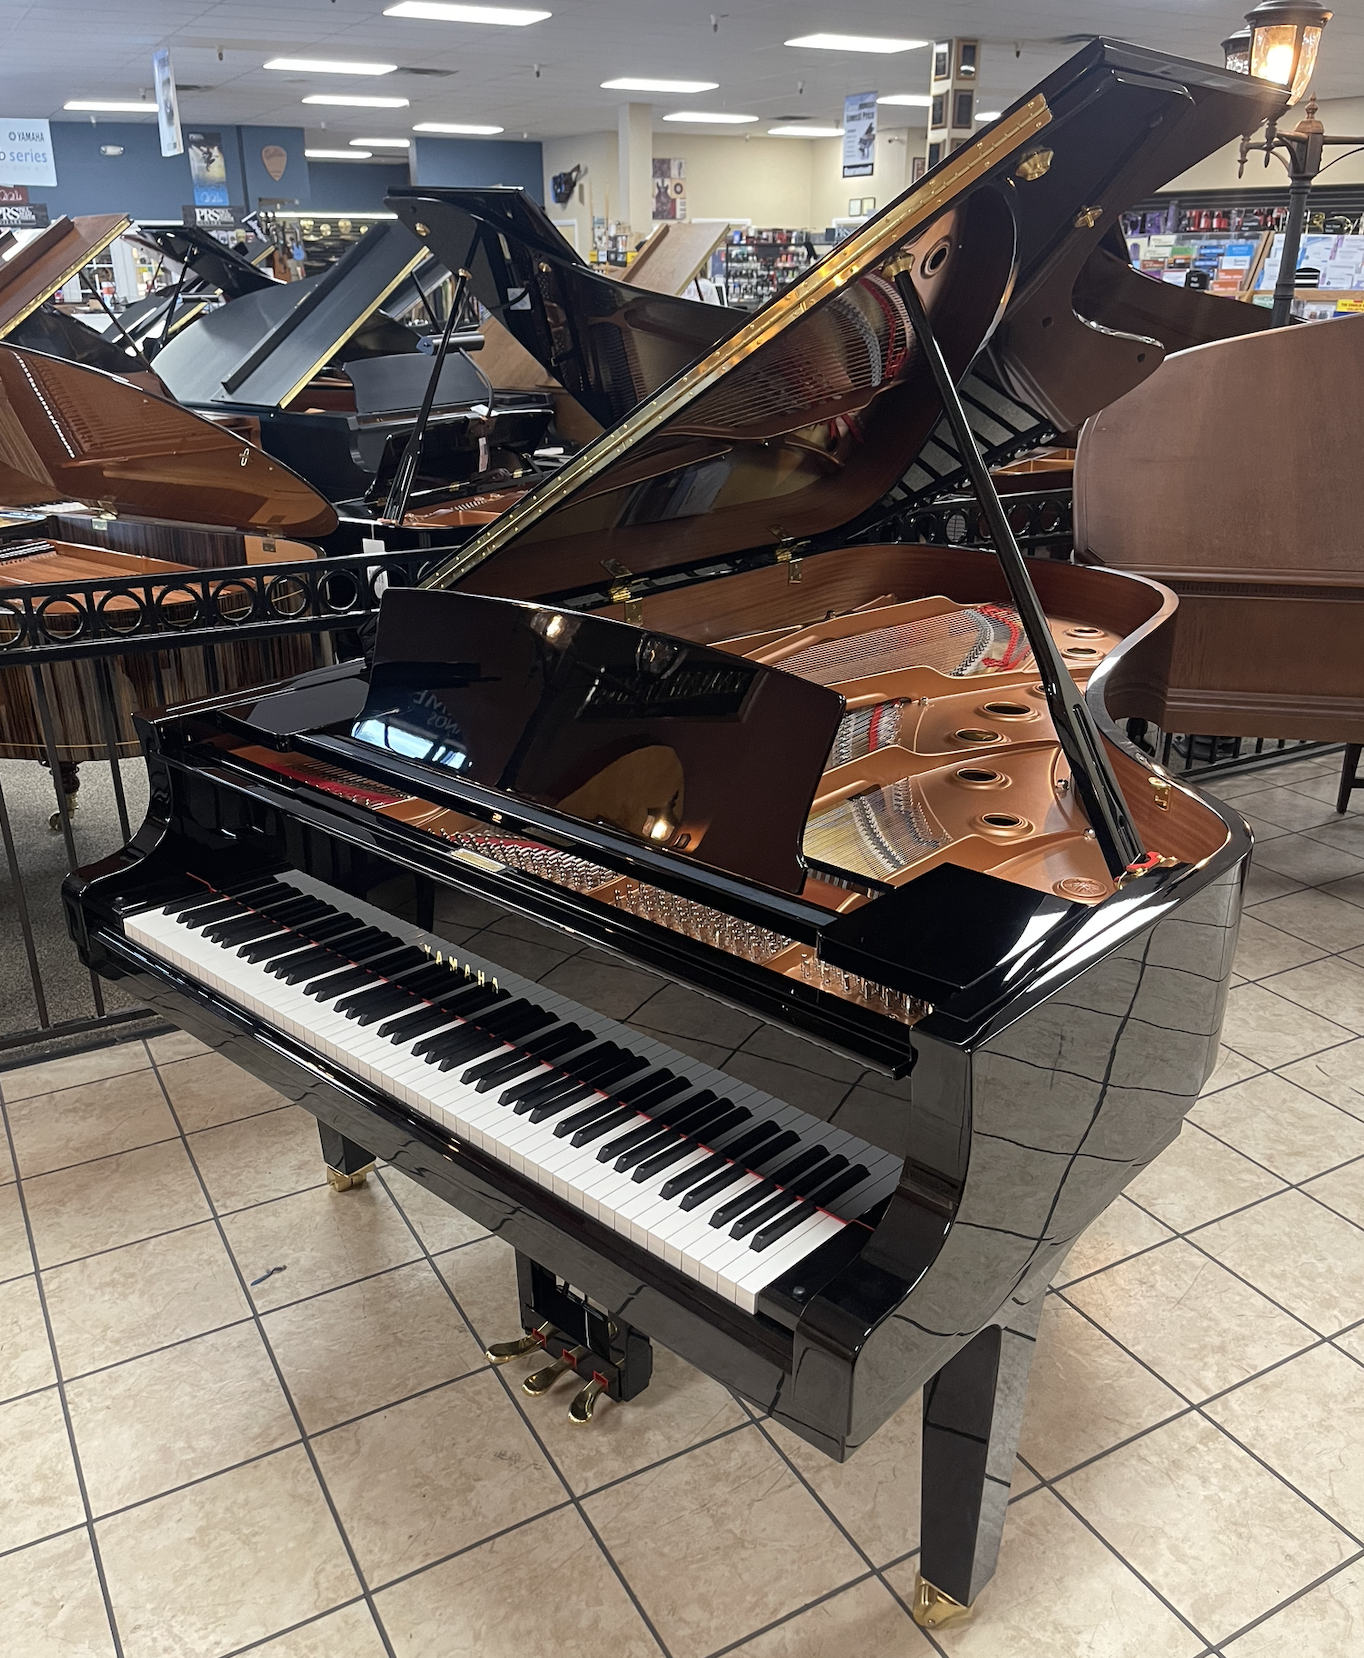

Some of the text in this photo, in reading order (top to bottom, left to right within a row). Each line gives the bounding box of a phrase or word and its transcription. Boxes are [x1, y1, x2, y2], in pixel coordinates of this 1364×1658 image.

[17, 132, 45, 142] YAMAHA
[9, 148, 47, 163] series
[194, 208, 220, 222] PRS
[423, 943, 500, 994] YAMAHA
